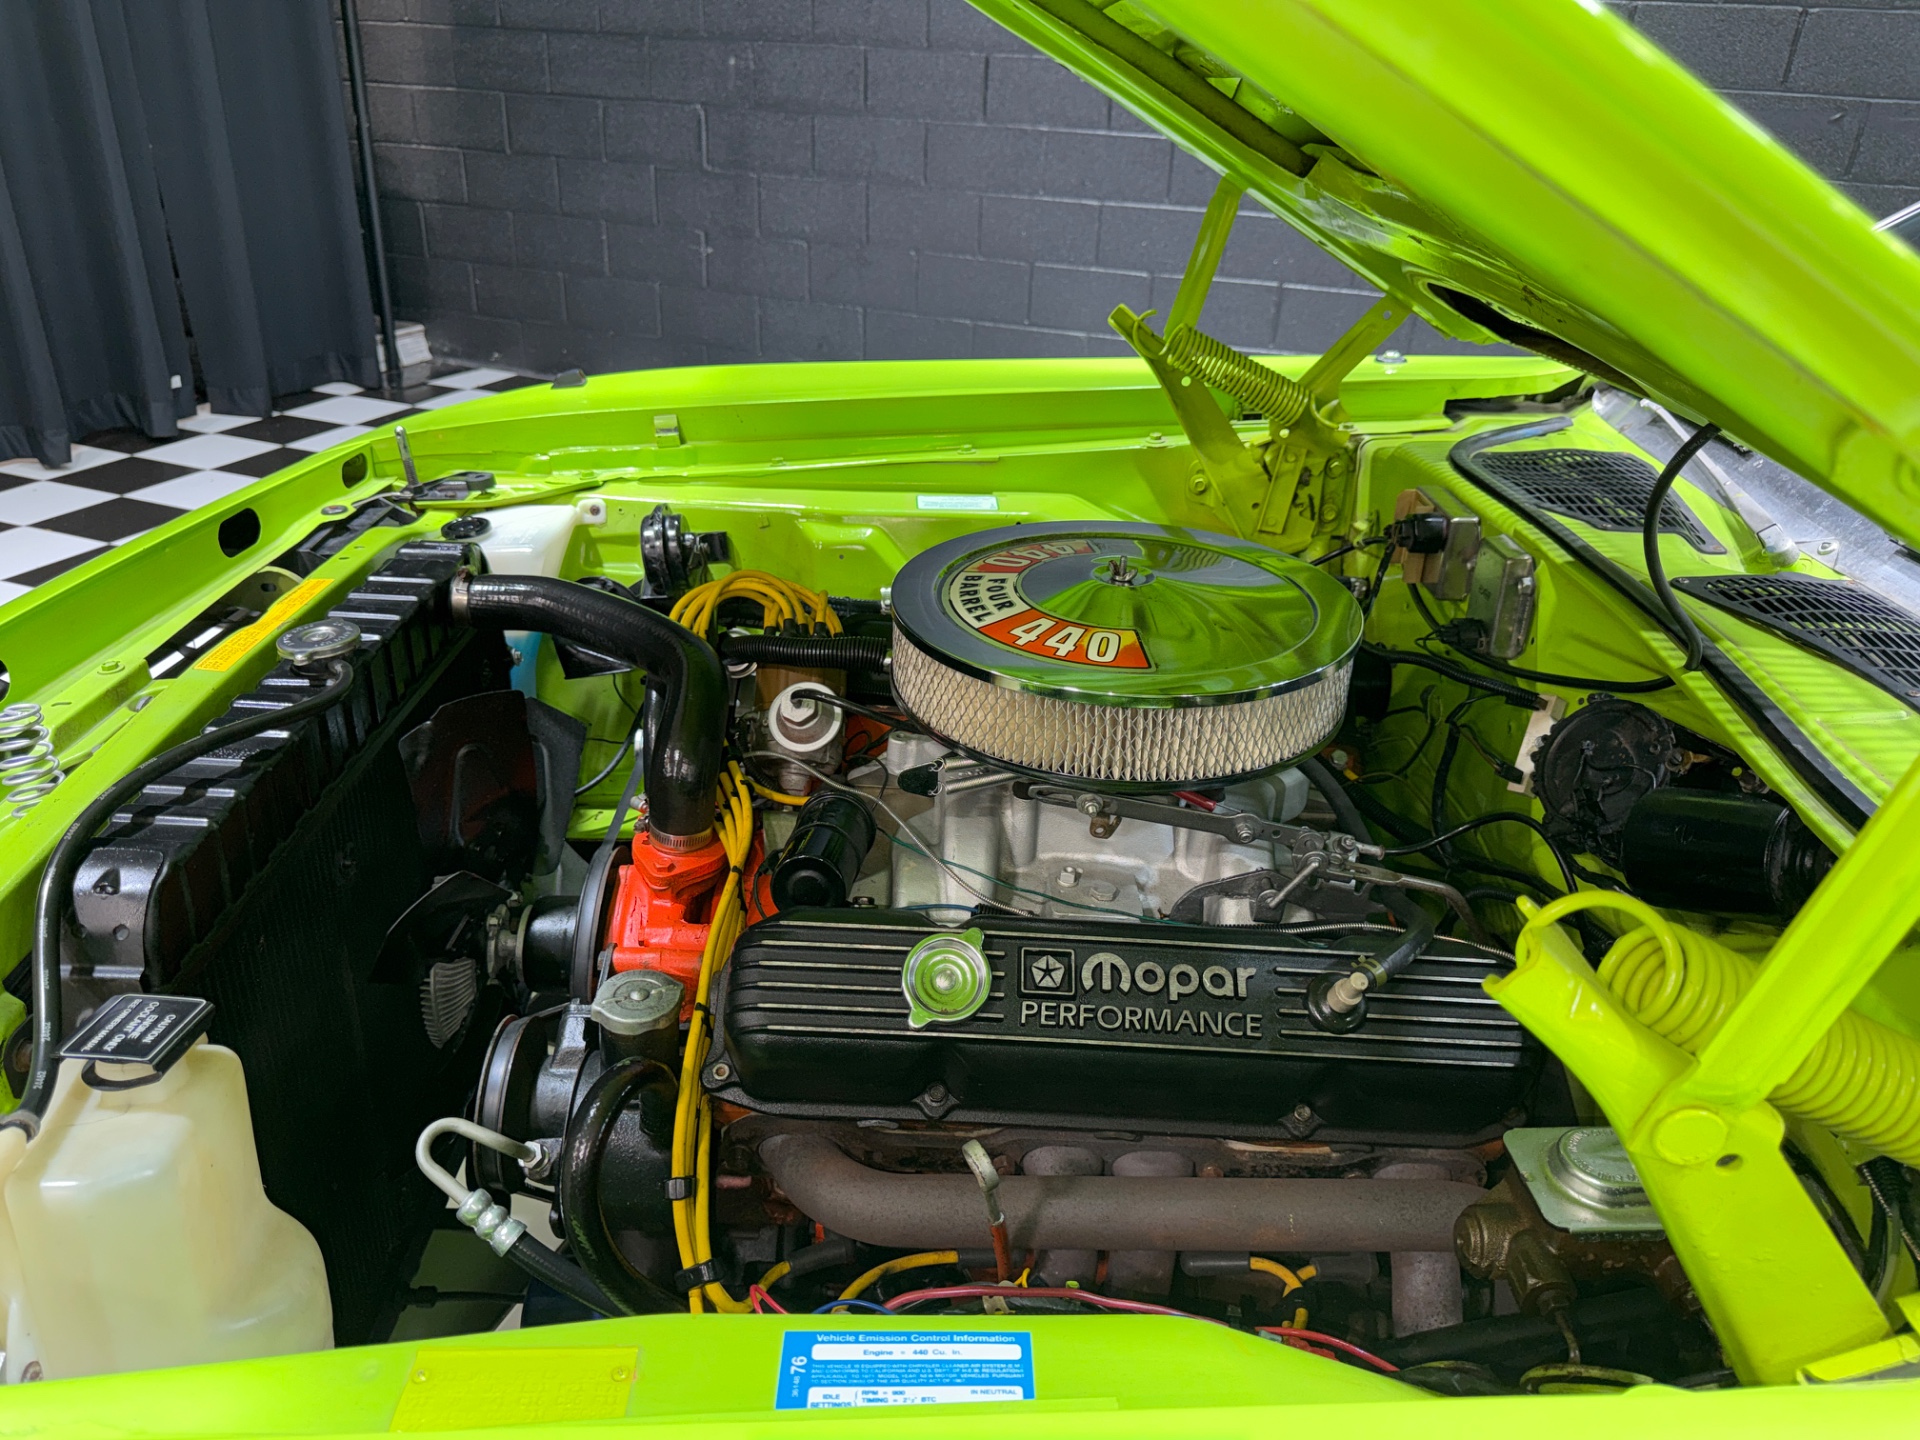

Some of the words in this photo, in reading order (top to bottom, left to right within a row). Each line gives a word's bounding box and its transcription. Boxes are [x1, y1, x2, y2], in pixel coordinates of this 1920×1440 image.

[958, 574, 990, 623] BARREL
[986, 577, 1016, 611] FOUR
[1009, 617, 1122, 663] 440
[1081, 952, 1257, 1002] Mopar
[123, 1001, 160, 1032] COOLANT
[127, 1014, 159, 1040] ENGINE
[142, 1014, 177, 1043] CAUTION
[1020, 1001, 1264, 1038] PERFORMANCE
[103, 1033, 126, 1052] ONLY
[817, 1334, 856, 1342] Vehicle
[858, 1334, 908, 1342] Emission
[911, 1334, 950, 1342] Control
[954, 1334, 1016, 1342] Information
[790, 1356, 808, 1374] 76
